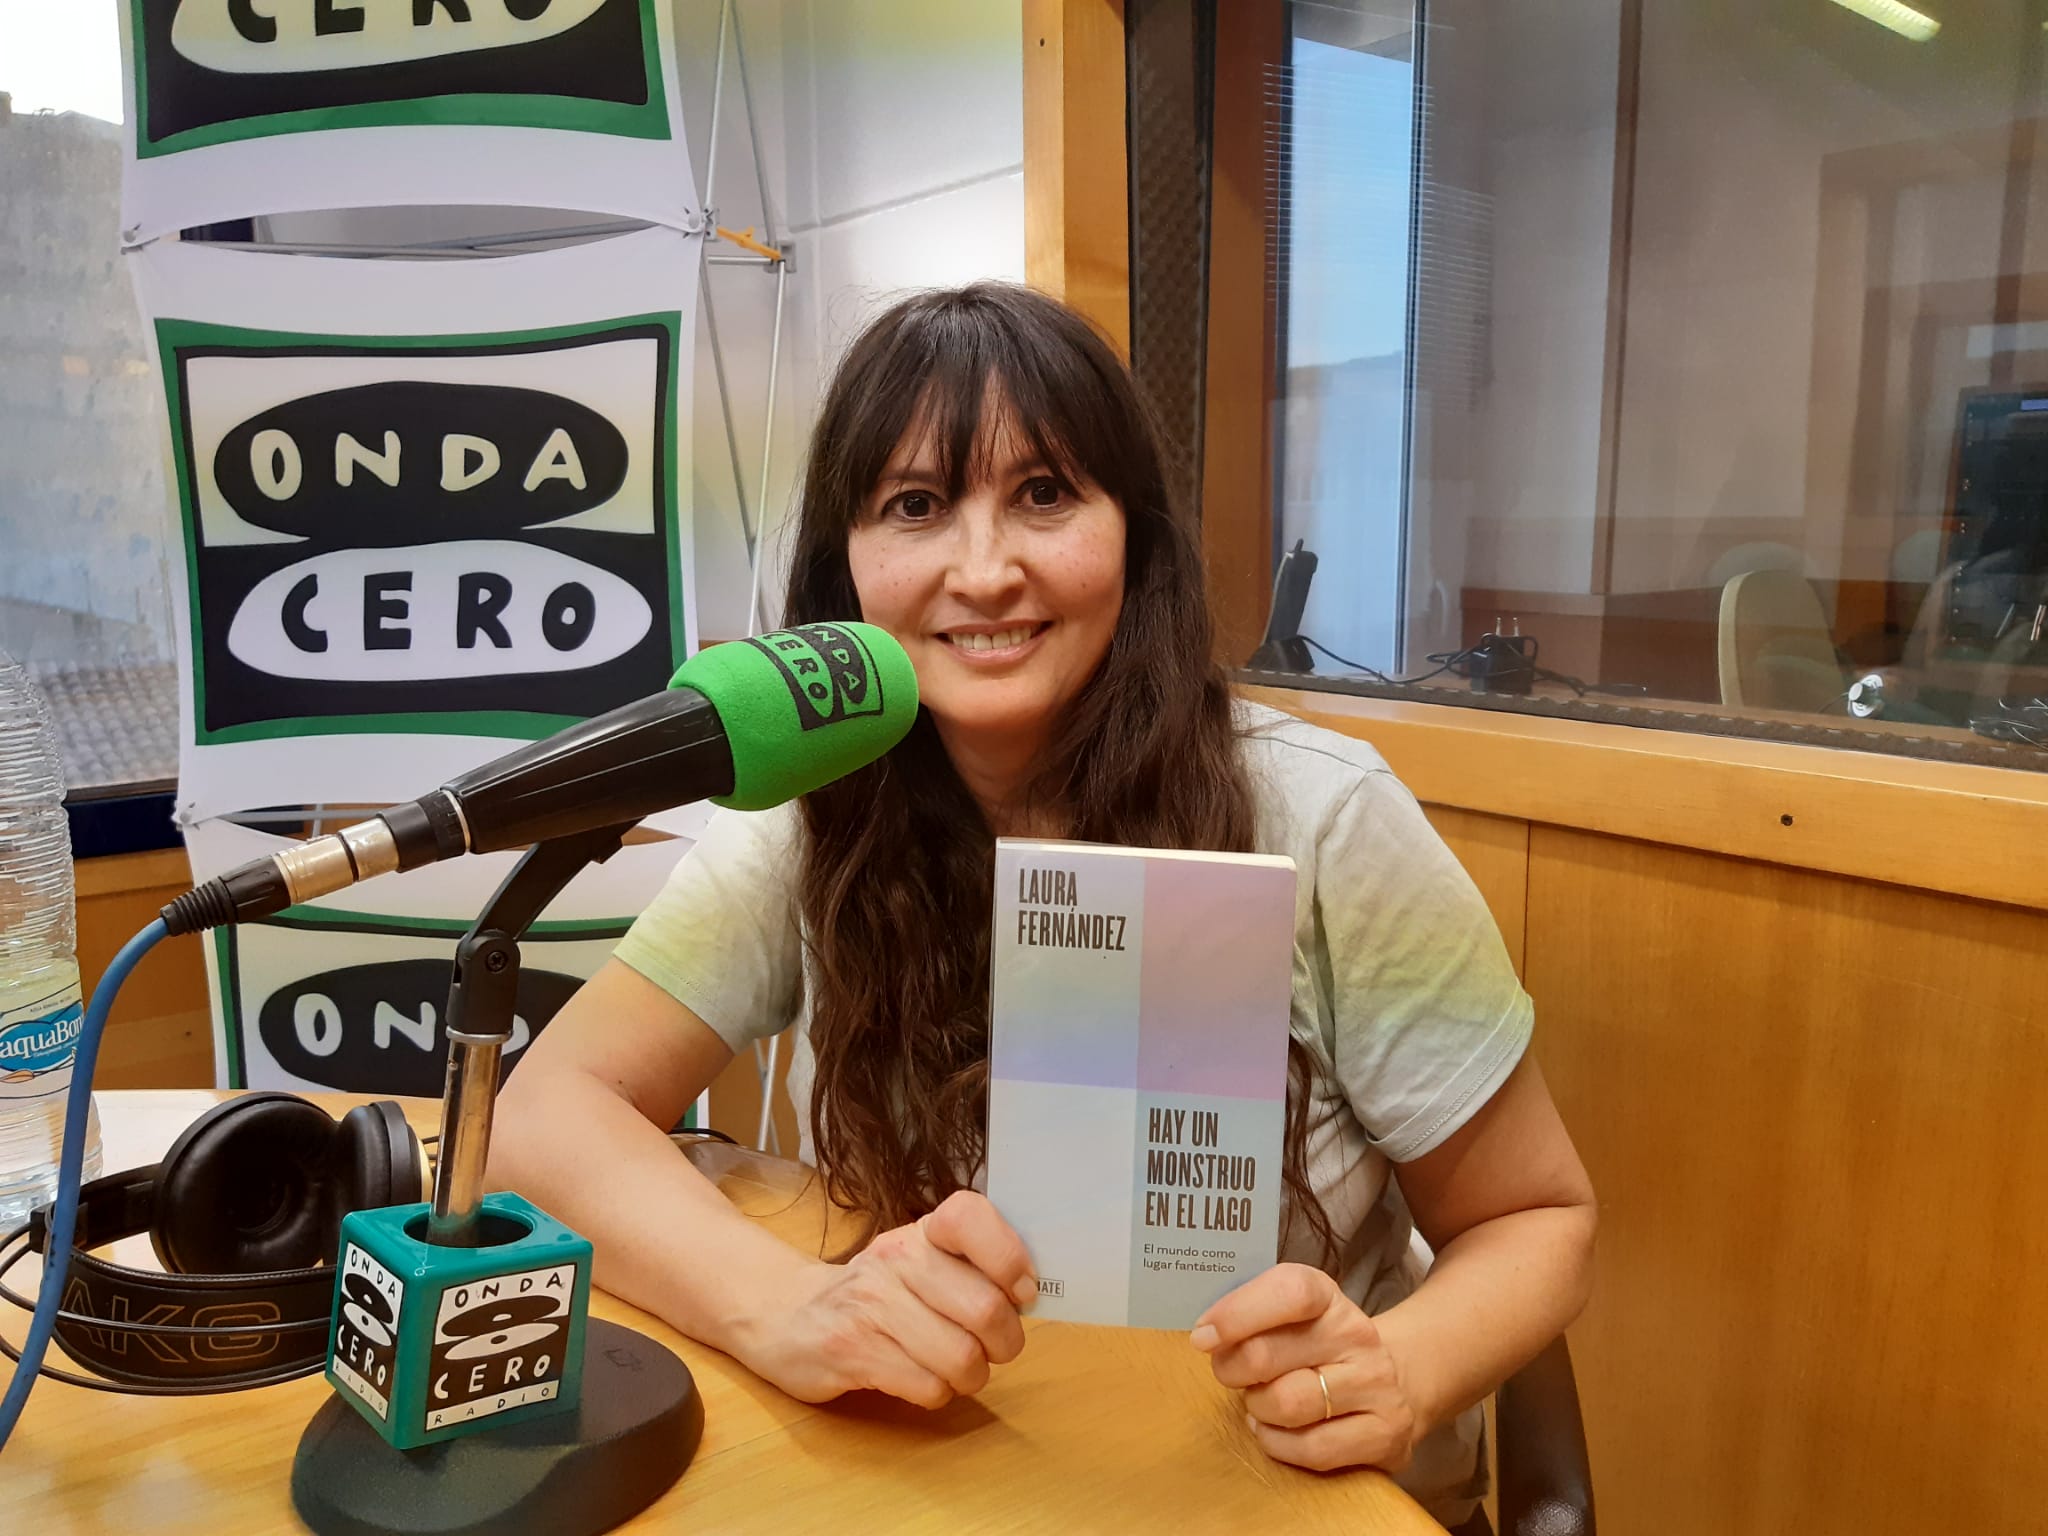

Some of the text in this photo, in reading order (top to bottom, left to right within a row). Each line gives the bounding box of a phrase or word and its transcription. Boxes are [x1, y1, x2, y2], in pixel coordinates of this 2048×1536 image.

[250, 428, 588, 501] ONDA
[281, 571, 596, 653] CERO
[1018, 868, 1078, 906] LAURA
[1017, 907, 1127, 951] FERNÁNDEZ
[1148, 1107, 1219, 1148] HAY UN
[1146, 1149, 1256, 1192] MONSTRUO
[1145, 1191, 1252, 1232] EN EL LAGO
[1143, 1258, 1236, 1273] lugar fantástico
[1144, 1243, 1236, 1259] El mundo como
[351, 1249, 397, 1298] ONDA
[454, 1272, 563, 1309] ONDA
[60, 1277, 282, 1364] AKG
[337, 1324, 387, 1387] CERO
[434, 1354, 551, 1400] CERO
[434, 1387, 550, 1425] RADIO
